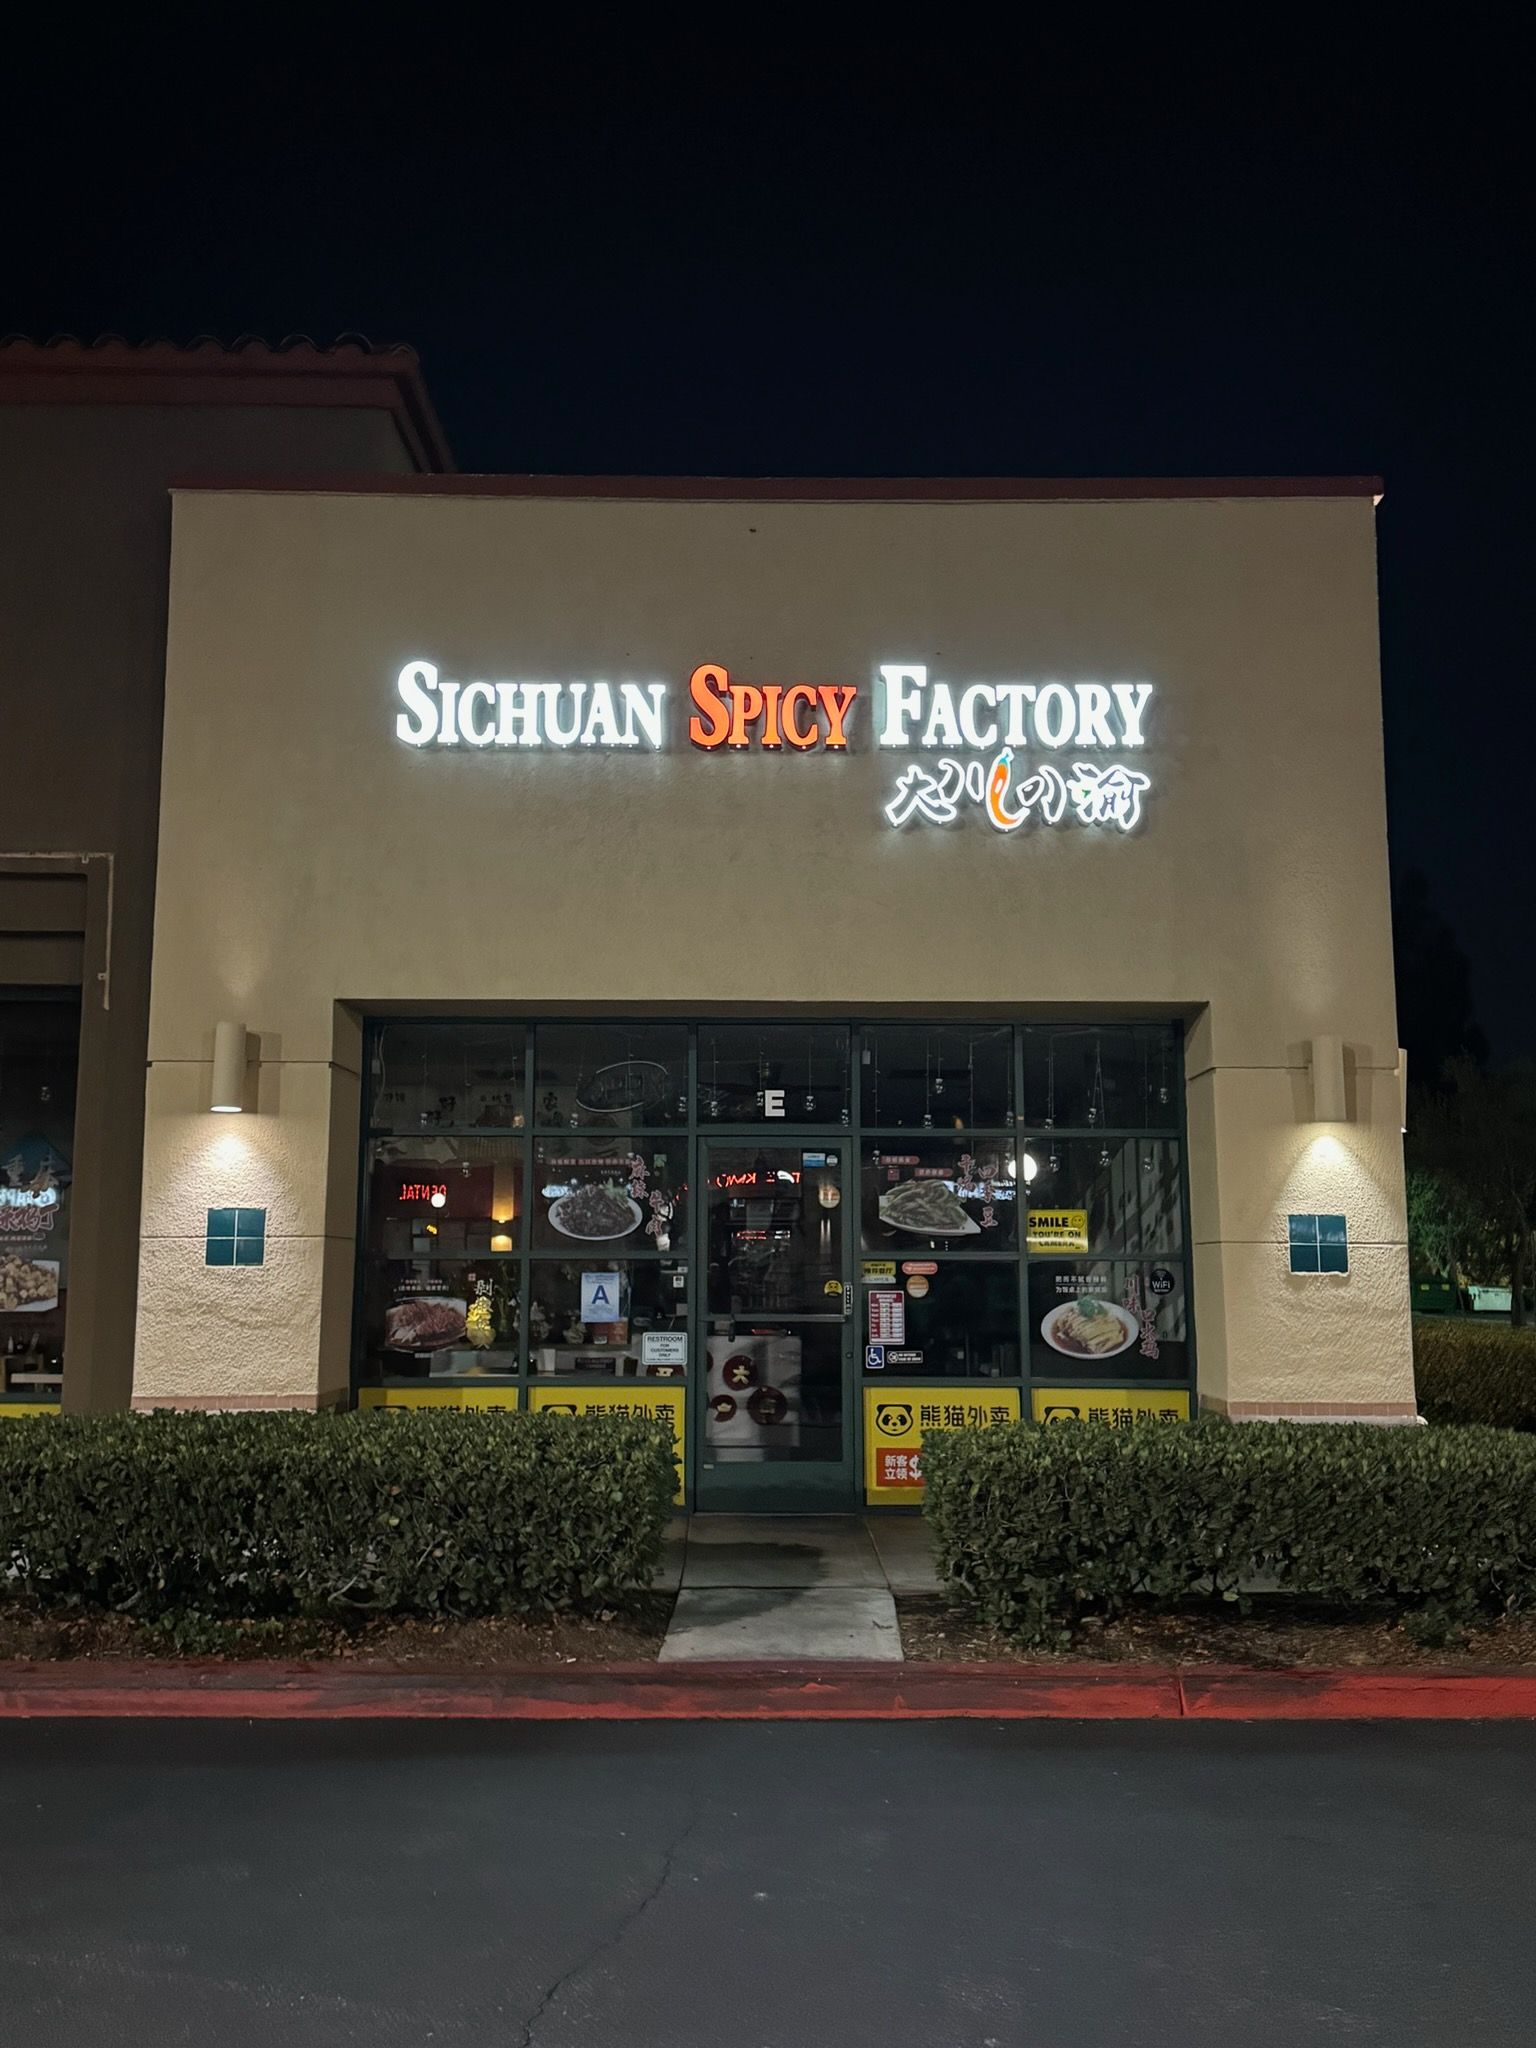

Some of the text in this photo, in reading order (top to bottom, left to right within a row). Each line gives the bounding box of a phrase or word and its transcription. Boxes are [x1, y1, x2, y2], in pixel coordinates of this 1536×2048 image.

[397, 661, 1153, 750] SICHUAN SPICY FACTORY
[765, 1090, 785, 1116] E
[1029, 1217, 1069, 1228] SMILE
[592, 1285, 610, 1305] A
[920, 1405, 1010, 1428] 熊猫外卖
